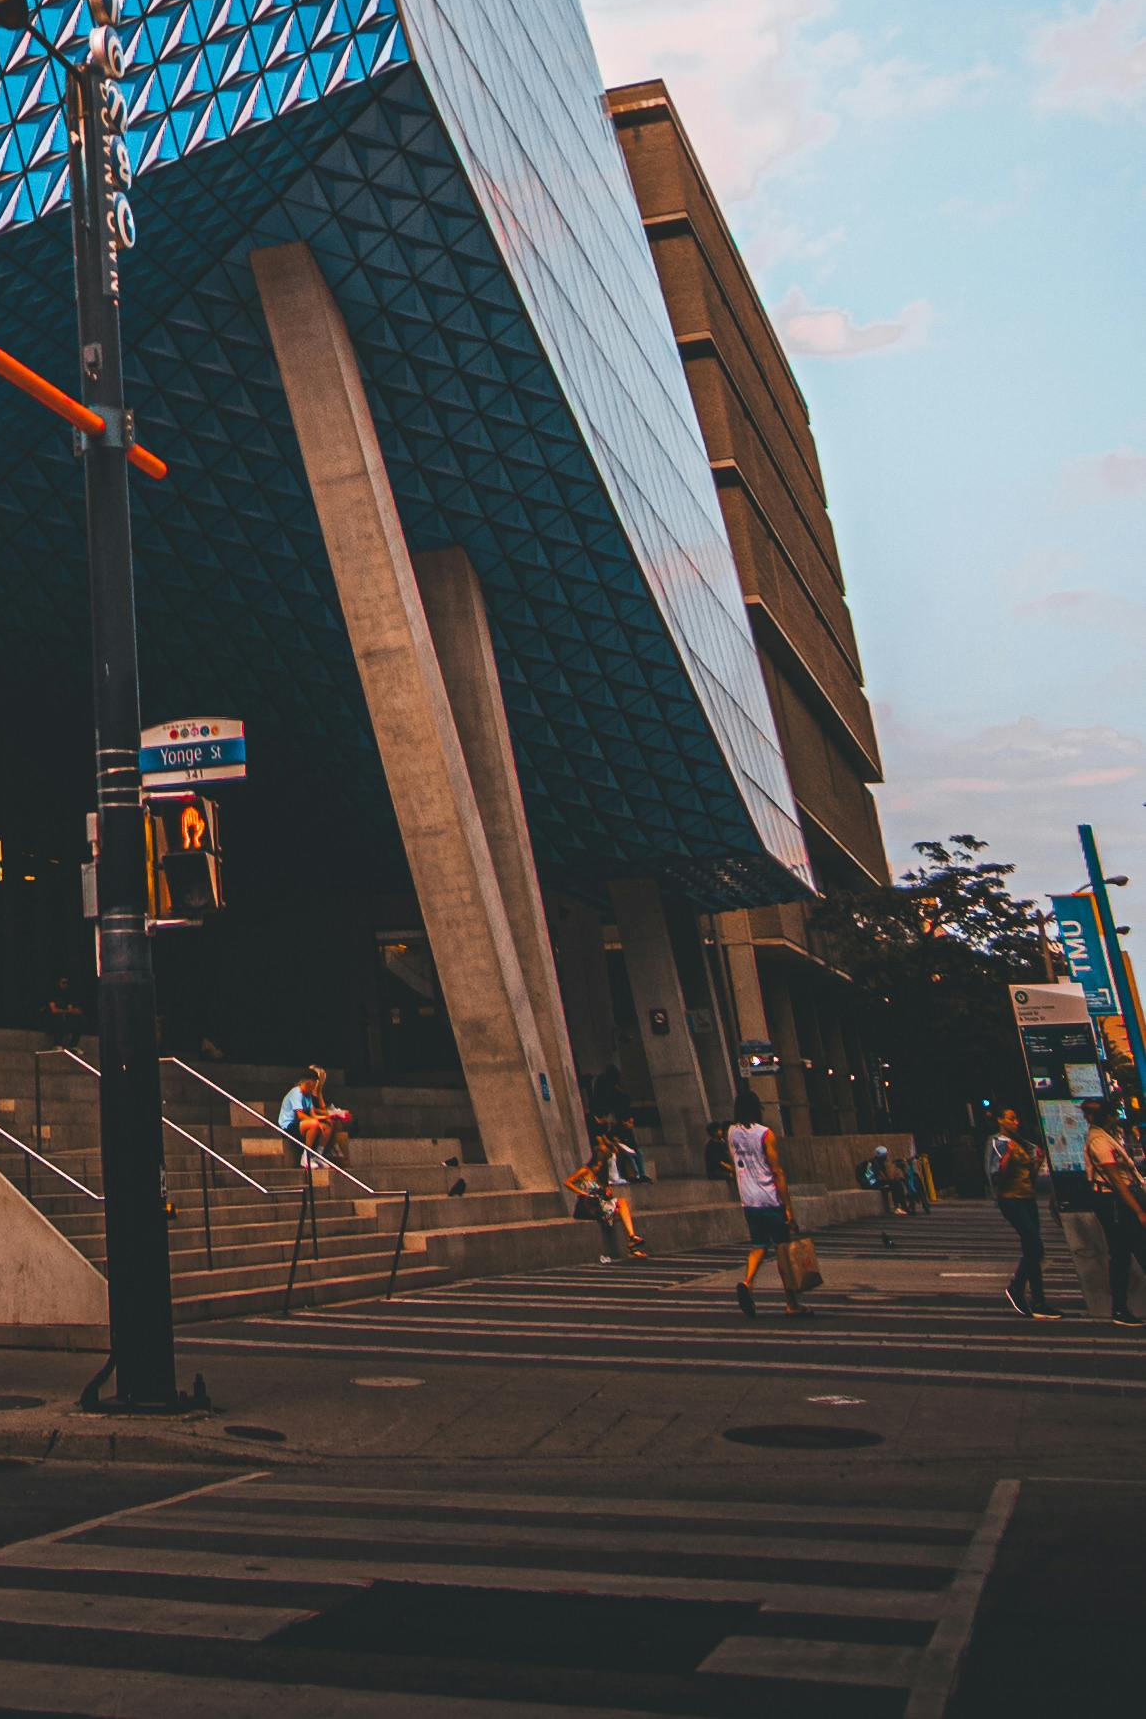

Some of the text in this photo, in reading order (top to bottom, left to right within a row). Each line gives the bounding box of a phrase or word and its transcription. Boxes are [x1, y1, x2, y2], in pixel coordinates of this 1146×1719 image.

[160, 744, 222, 766] Yonge St
[1060, 919, 1093, 978] TMU
